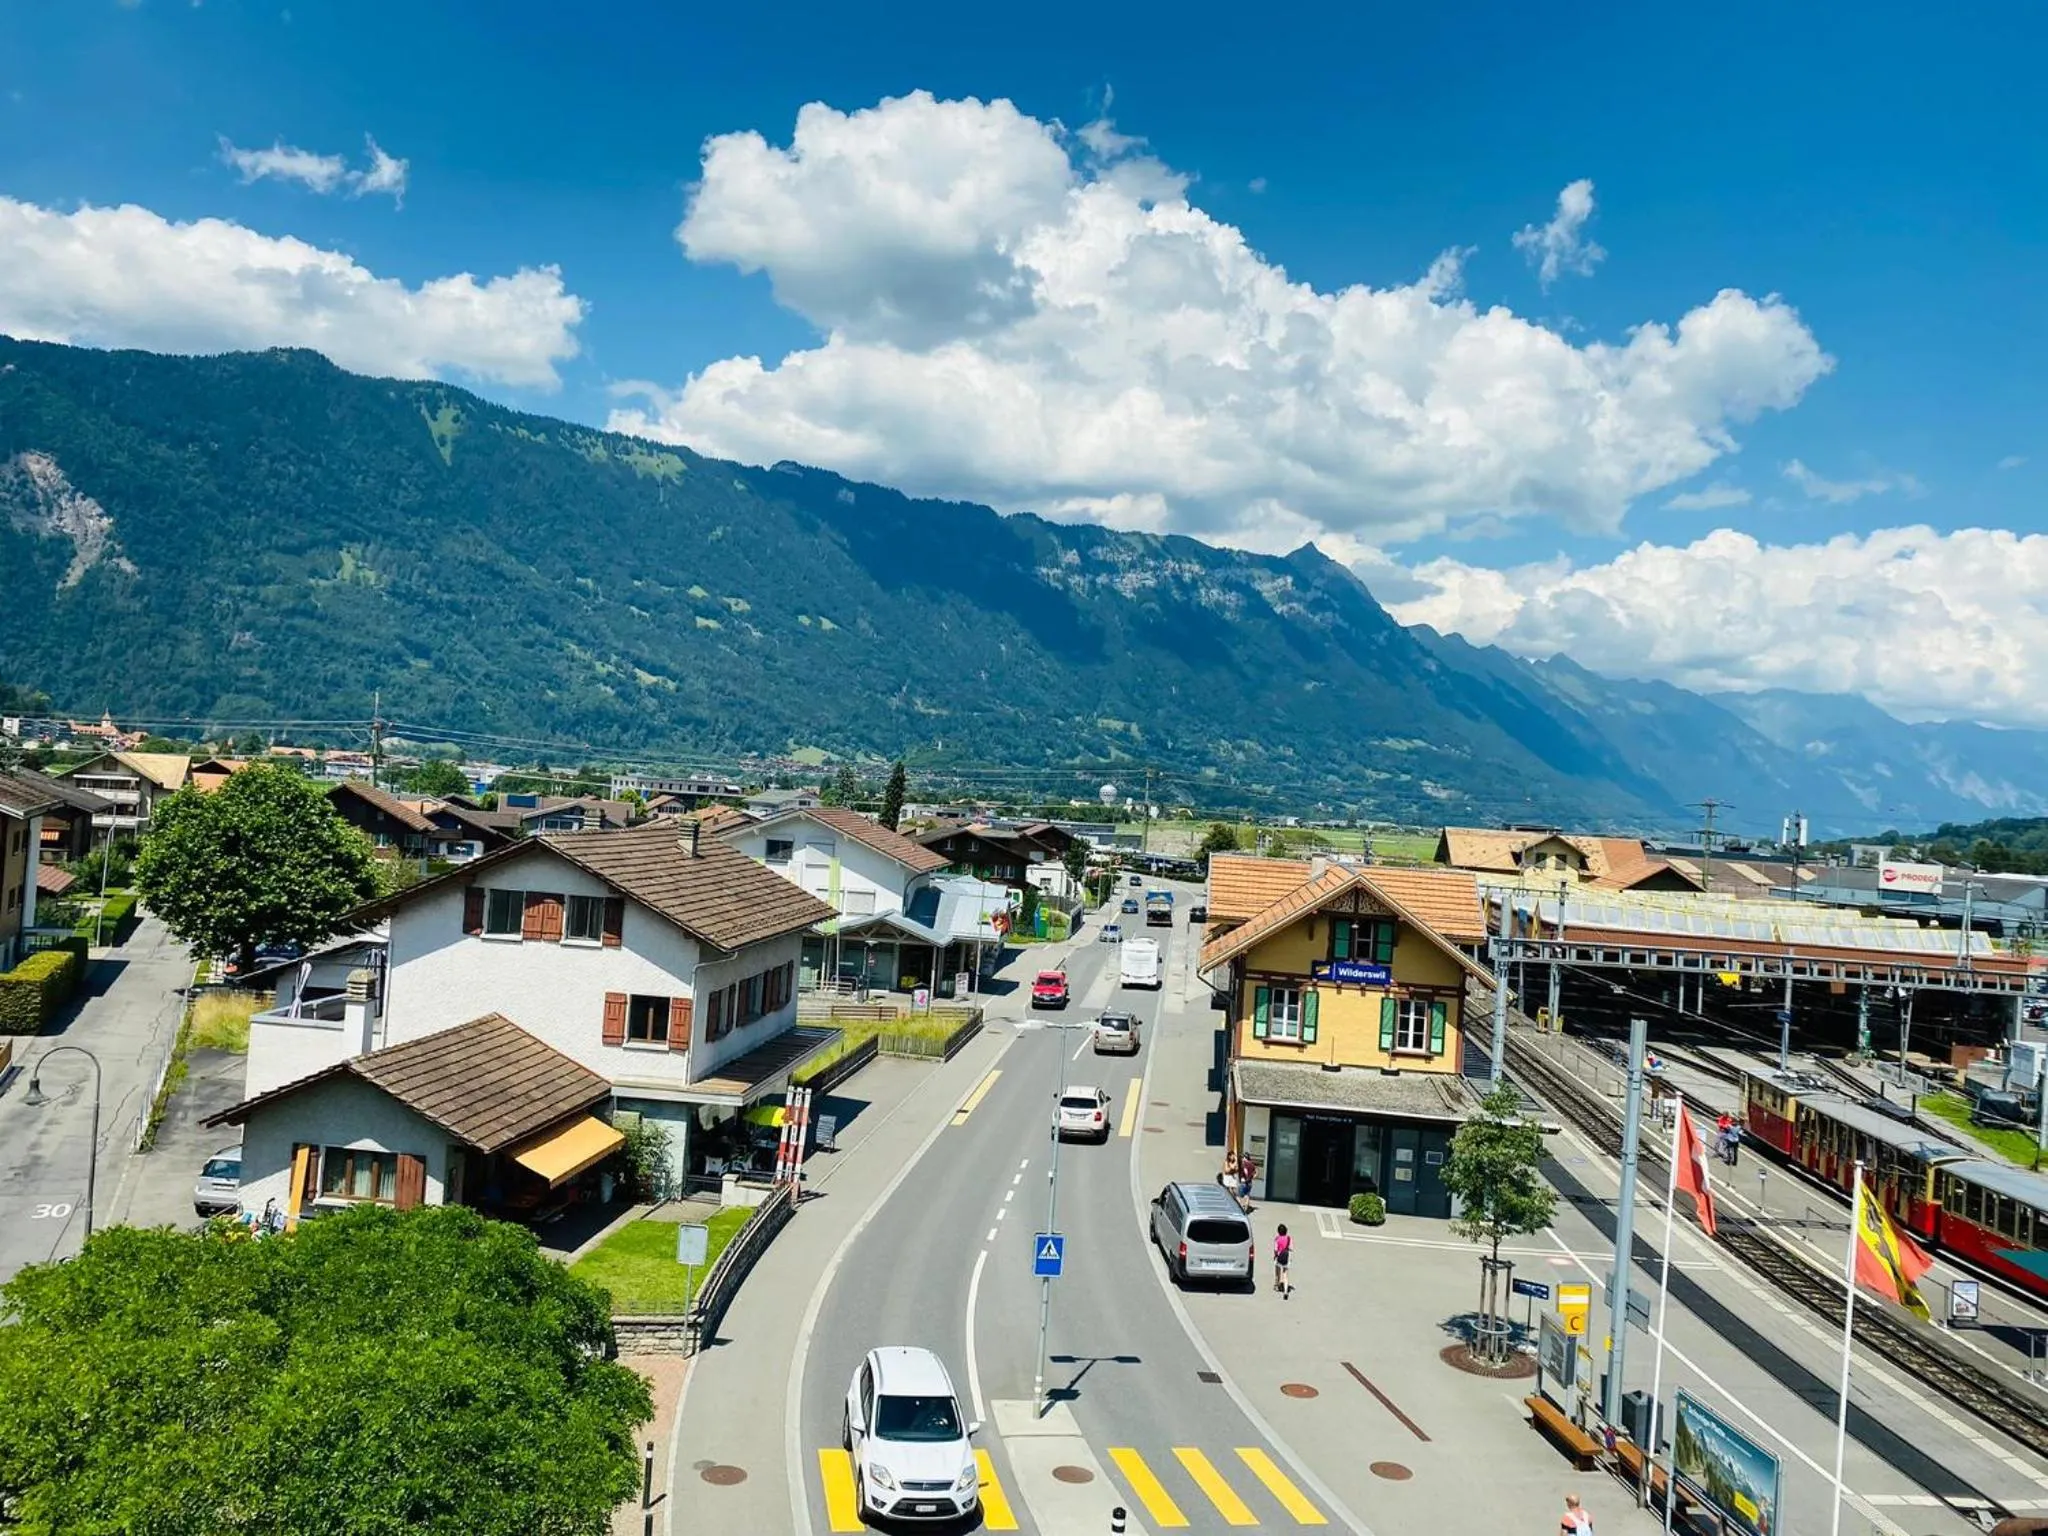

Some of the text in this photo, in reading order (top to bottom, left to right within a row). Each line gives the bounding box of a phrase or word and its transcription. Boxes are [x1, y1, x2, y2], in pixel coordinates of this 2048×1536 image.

[1337, 967, 1387, 980] Wilderswil
[31, 1203, 71, 1219] 30
[1570, 1316, 1580, 1331] C
